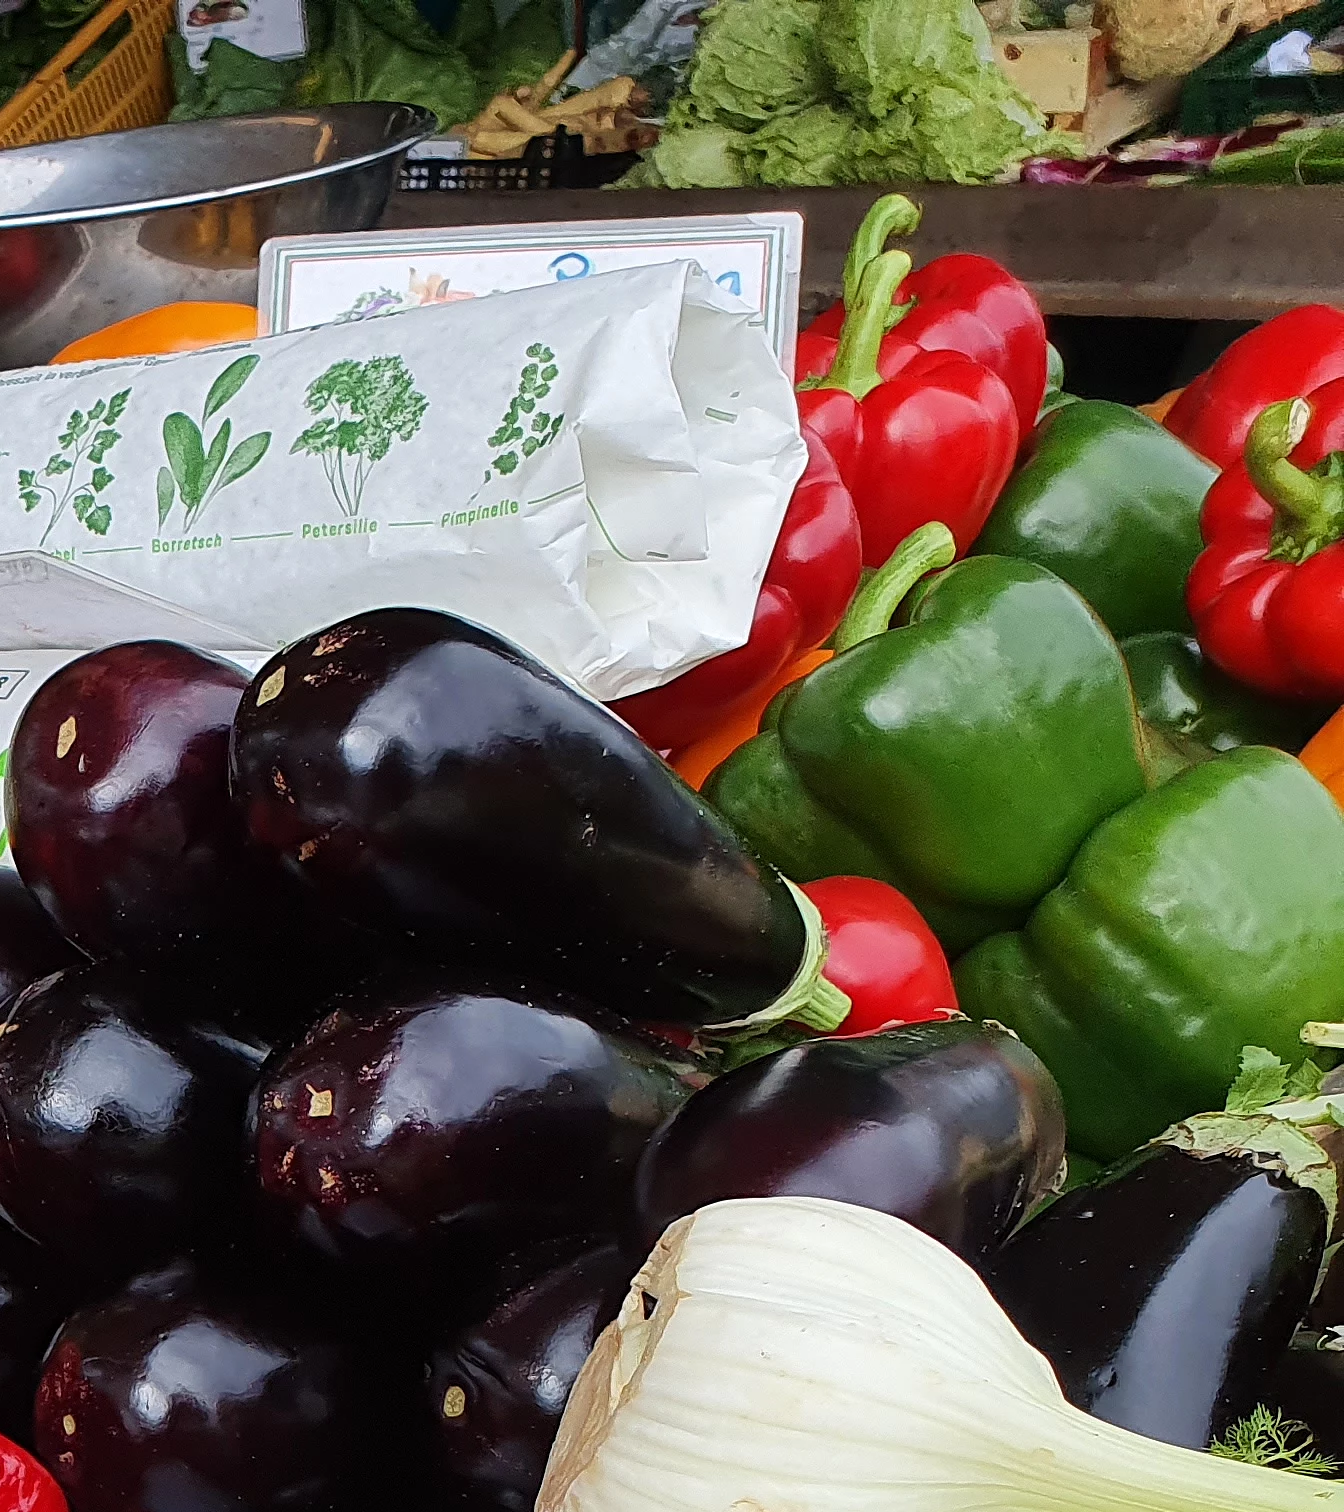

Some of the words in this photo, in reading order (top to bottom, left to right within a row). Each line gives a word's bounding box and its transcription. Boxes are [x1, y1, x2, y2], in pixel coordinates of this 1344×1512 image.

[151, 533, 223, 553] Borretsch
[301, 518, 378, 539] Petersilie
[440, 498, 519, 528] Pimpinelle
